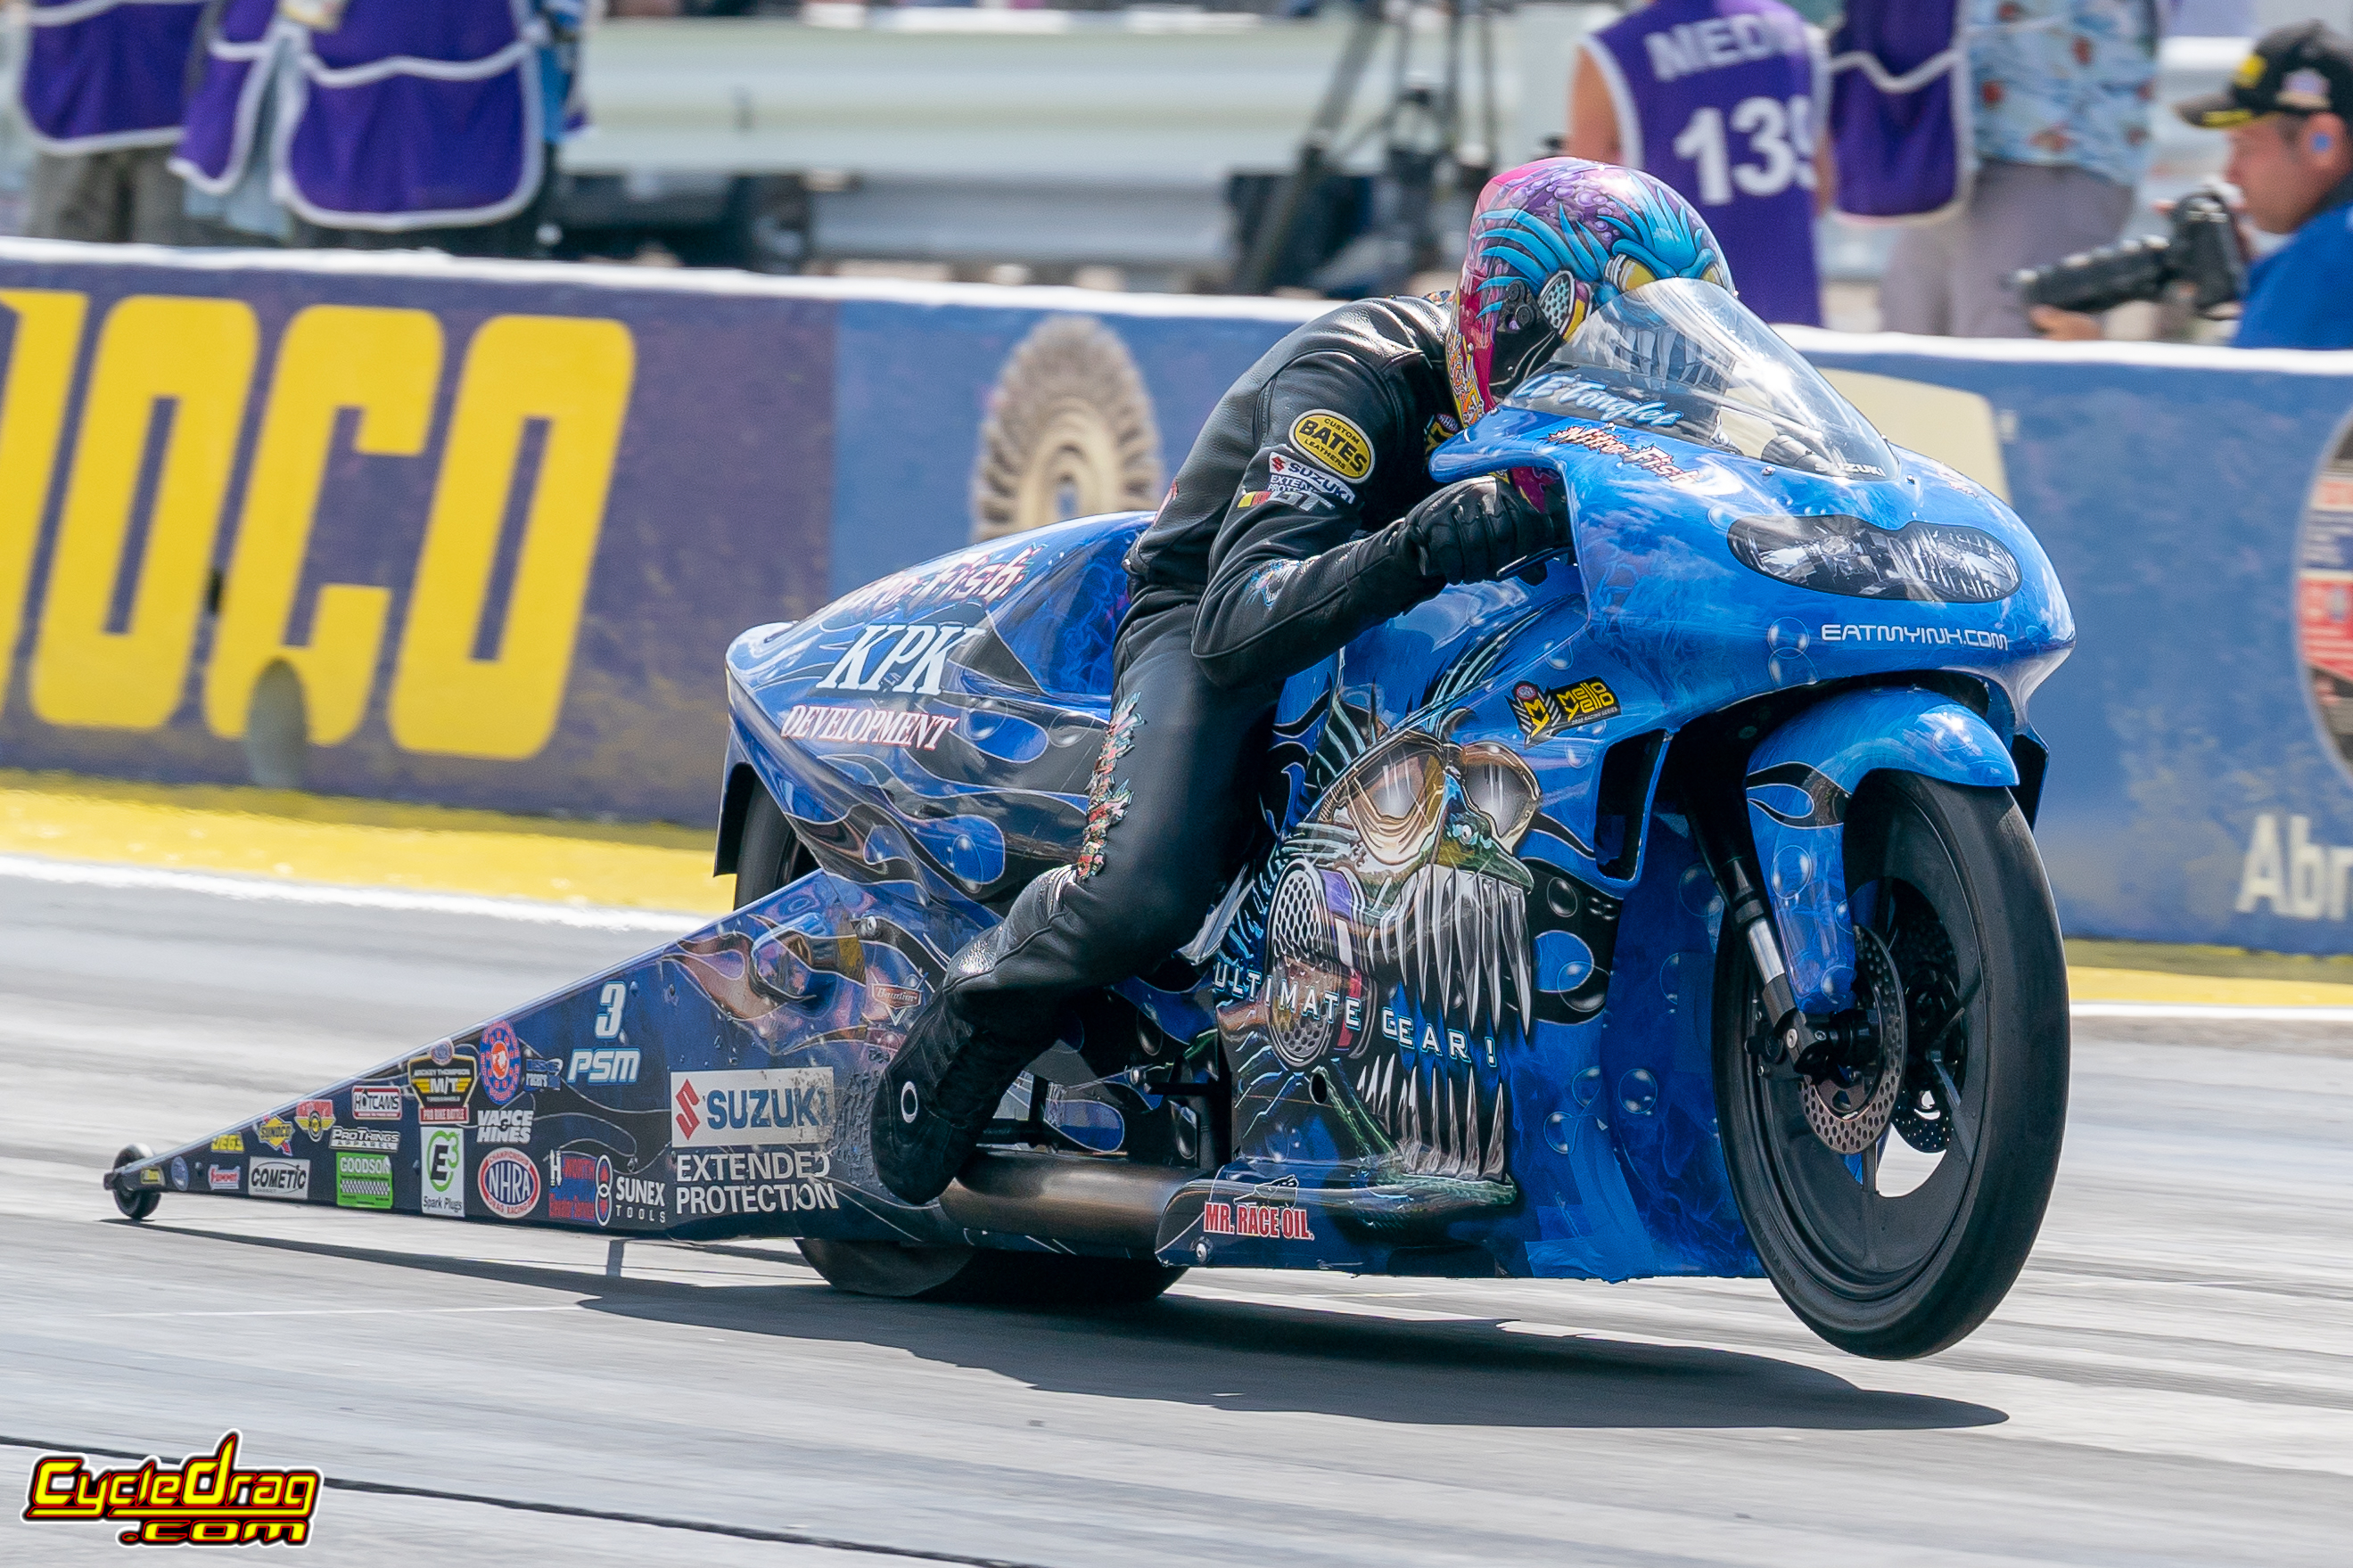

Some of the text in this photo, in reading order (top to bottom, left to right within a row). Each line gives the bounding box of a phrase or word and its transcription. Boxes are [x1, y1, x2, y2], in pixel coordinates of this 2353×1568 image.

[1559, 381, 1683, 426] Tonglet
[1299, 420, 1368, 472] BATES
[1324, 418, 1361, 444] CUSTOM
[1304, 439, 1347, 470] LEATHERS
[1814, 462, 1887, 478] SUZUKI
[1288, 462, 1353, 503] SUZUKI
[1821, 624, 2009, 651] EATMYINK.COM
[815, 624, 986, 695] KPK
[780, 705, 958, 751] DEVELOPMENT
[595, 981, 626, 1039] 3
[1214, 960, 1362, 1031] ULTIMATE
[1381, 1006, 1471, 1064] GEAR
[567, 1047, 640, 1083] PSM
[430, 1076, 458, 1095] M/T
[477, 1110, 534, 1127] VANCE
[707, 1088, 828, 1130] SUZUKI
[476, 1126, 531, 1144] HINES
[251, 1165, 308, 1190] COMETIC
[340, 1156, 391, 1175] GOODSON
[676, 1151, 831, 1182] EXTENDED
[488, 1162, 531, 1203] NHRA
[615, 1176, 666, 1207] SUNEX
[423, 1195, 463, 1212] Spark Plugs
[615, 1204, 666, 1224] TOOLS
[676, 1183, 840, 1214] PROTECTION
[1205, 1201, 1235, 1235] MR.
[1237, 1204, 1280, 1237] RACE
